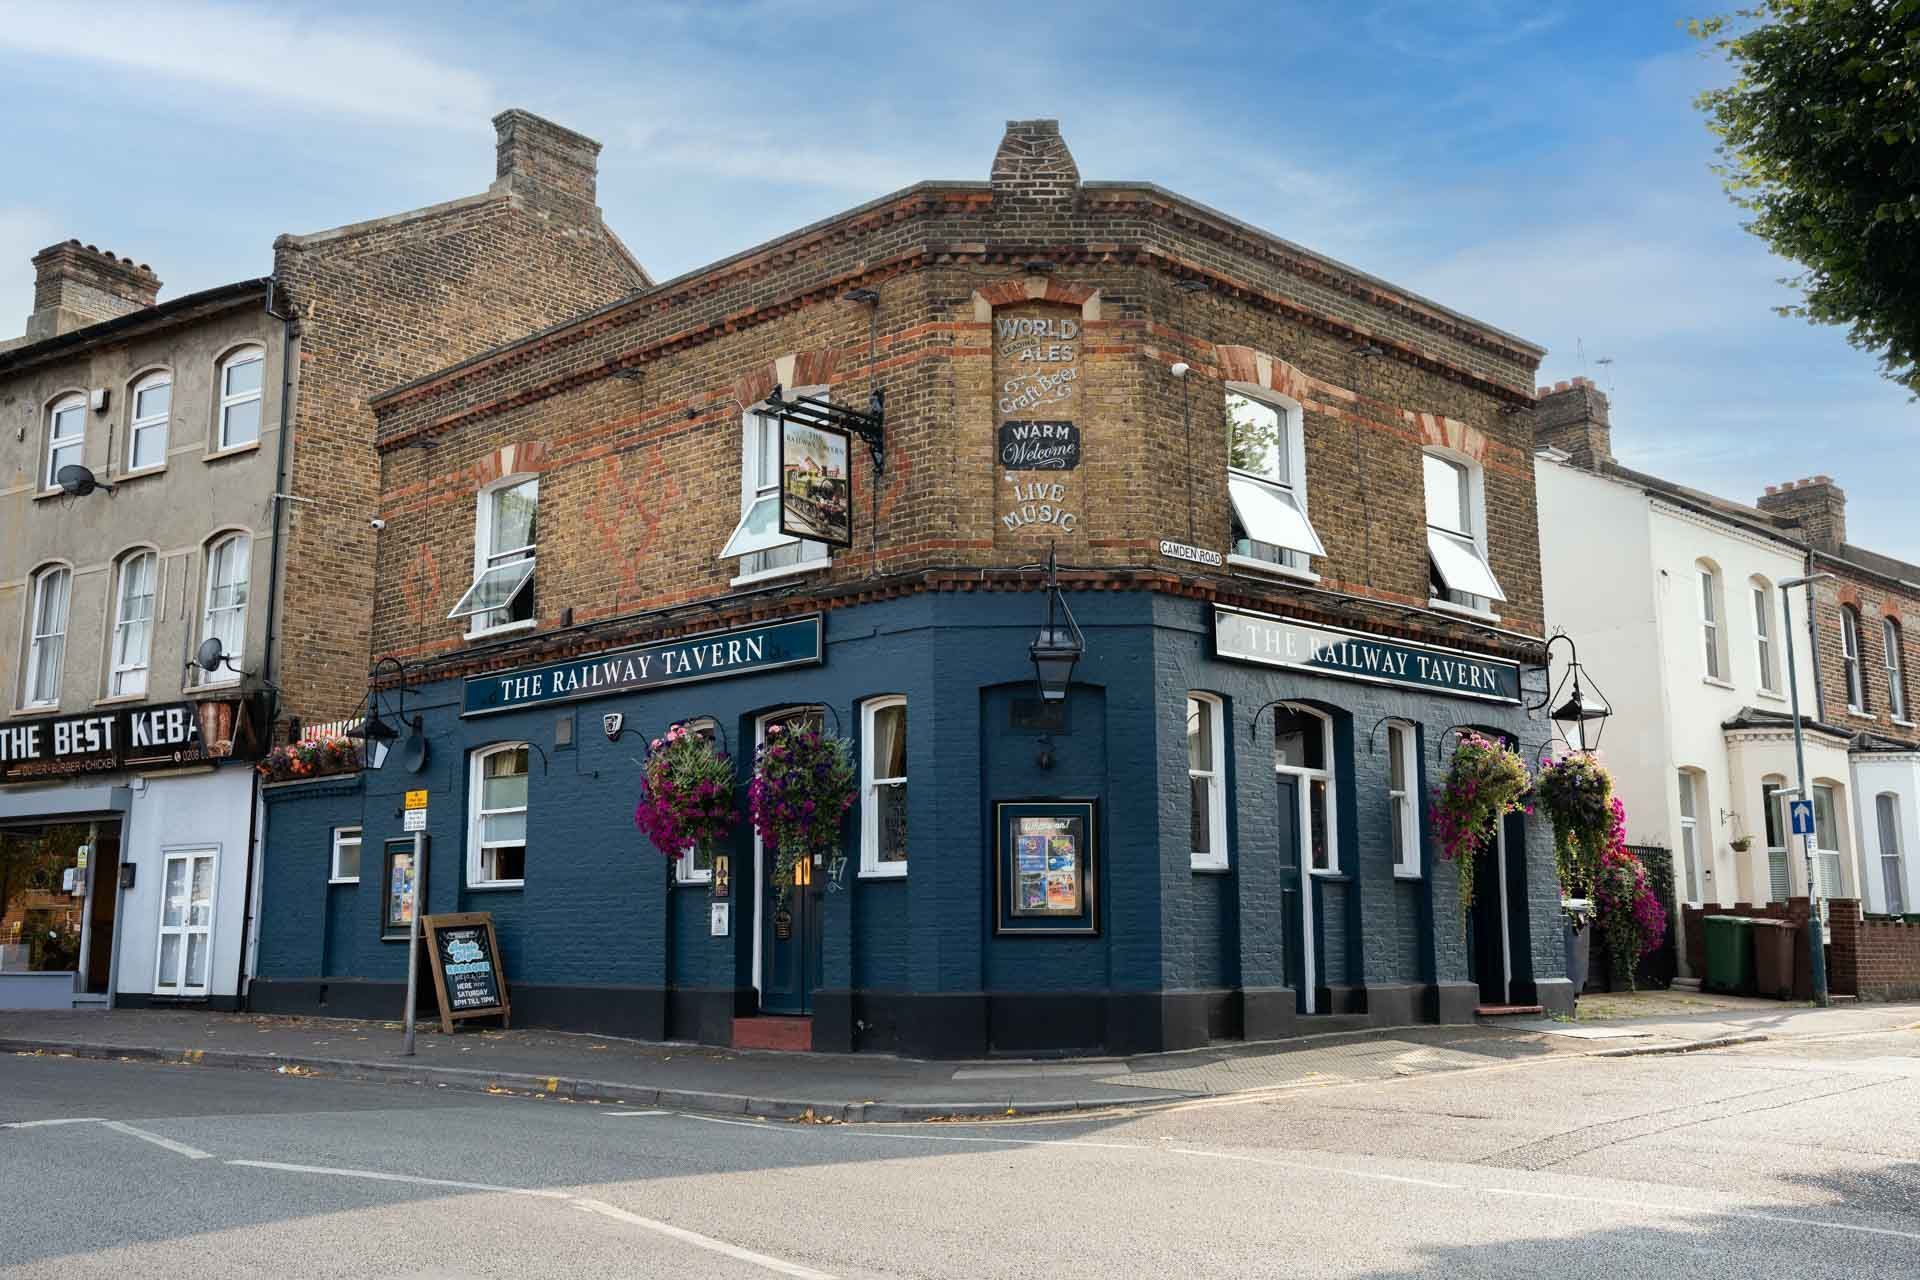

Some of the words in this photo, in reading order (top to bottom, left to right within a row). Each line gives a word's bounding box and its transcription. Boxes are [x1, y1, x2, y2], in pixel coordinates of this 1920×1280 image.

[996, 319, 1078, 340] WORLD
[1020, 345, 1073, 362] ALES
[999, 386, 1042, 413] Craft
[1040, 368, 1078, 392] Beer
[1012, 425, 1070, 440] WARM
[1002, 441, 1076, 465] Welcome
[1014, 483, 1065, 502] LIVE
[1002, 505, 1077, 532] MUSIC
[1161, 542, 1197, 560] CAMDEN
[1200, 551, 1221, 564] ROAD
[501, 674, 543, 701] THE
[552, 656, 651, 693] RAILWAY
[662, 635, 765, 675] TAVERN
[1246, 625, 1297, 657] THE
[1310, 636, 1408, 676] RAILWAY
[1417, 656, 1496, 690] TAVERN
[0, 725, 41, 760] THE
[54, 716, 116, 755] BEST
[85, 758, 117, 771] CHICKEN
[827, 857, 848, 881] 47
[446, 962, 489, 974] KARAOKE
[457, 988, 488, 998] SATURDAY
[467, 997, 480, 1005] TILL
